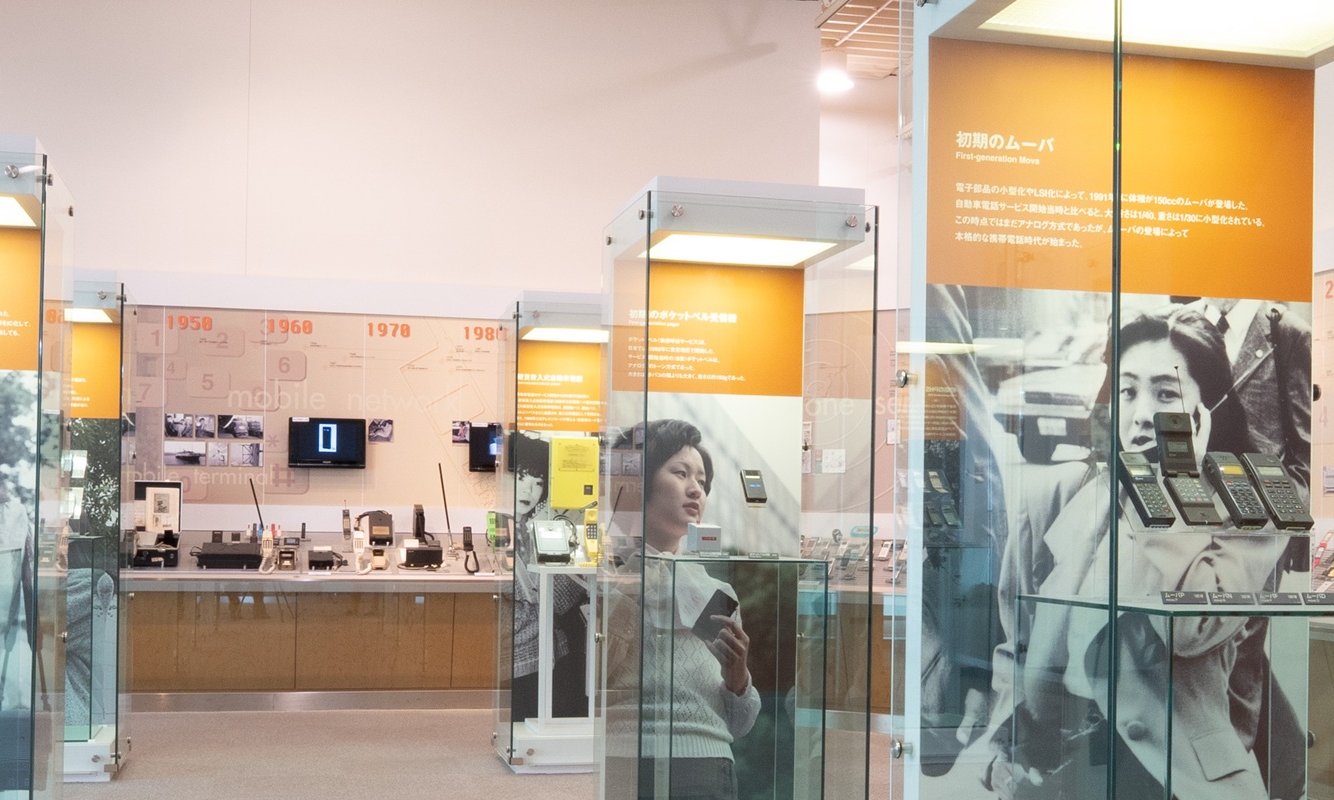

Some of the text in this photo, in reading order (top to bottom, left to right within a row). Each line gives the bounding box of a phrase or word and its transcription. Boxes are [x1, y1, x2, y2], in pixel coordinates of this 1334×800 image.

[956, 130, 1055, 152] 初期のムーバ
[955, 151, 1041, 166] First-generation Mova
[955, 198, 1265, 228] 自動車電話サービス開始当時と比べると、大さは1/40、重さは1/30に小型化されている。
[955, 231, 1083, 249] 本格的な携帯電話時代が始まった。
[166, 314, 213, 331] 1950
[267, 318, 313, 334] 1960
[367, 321, 411, 338] 1970
